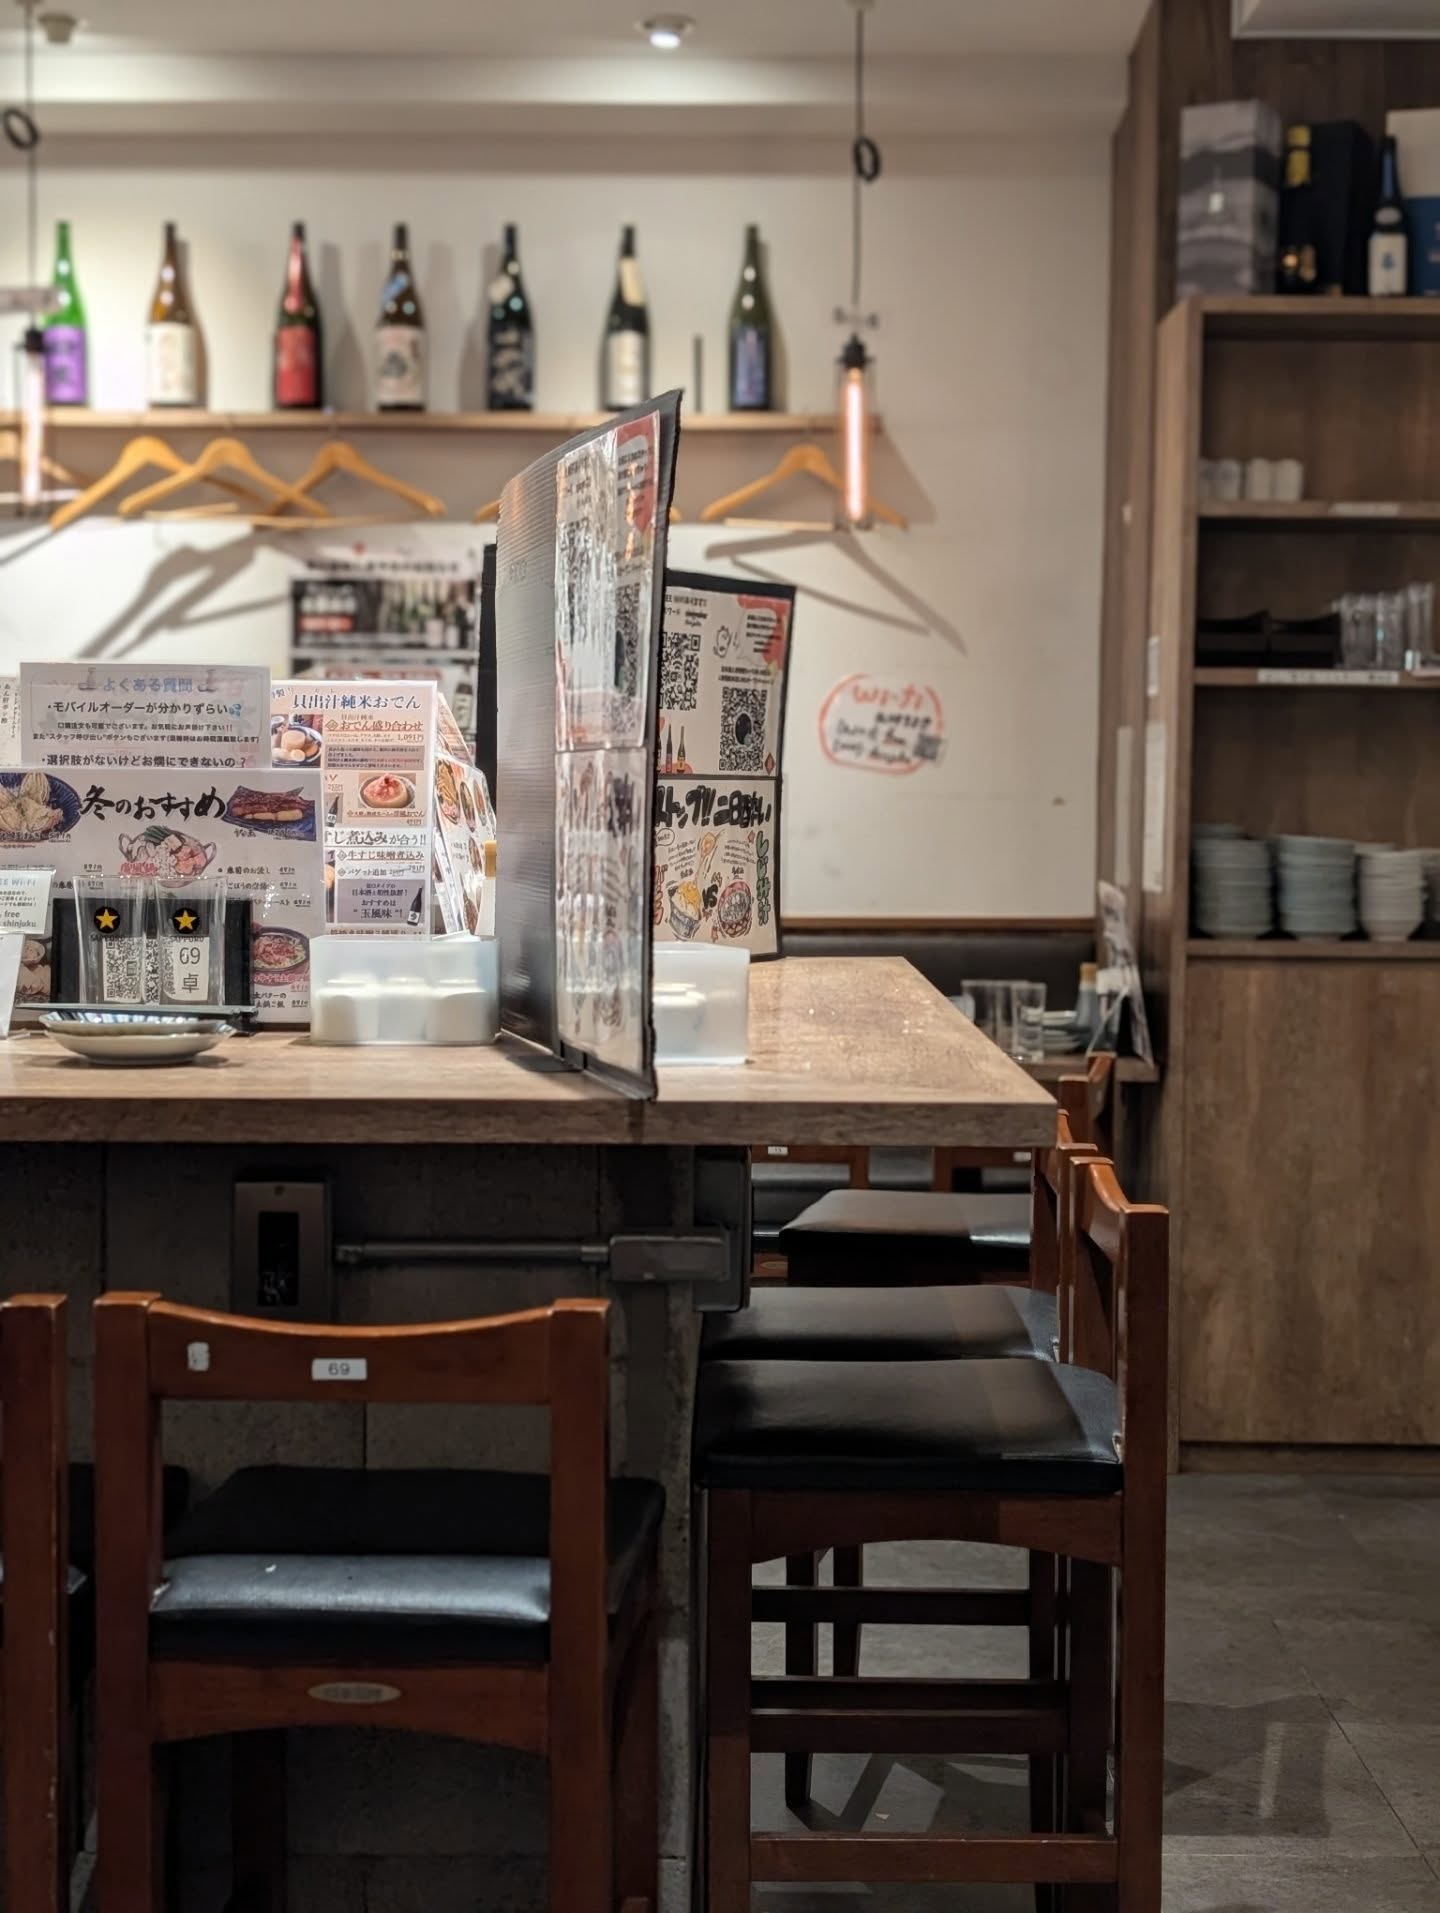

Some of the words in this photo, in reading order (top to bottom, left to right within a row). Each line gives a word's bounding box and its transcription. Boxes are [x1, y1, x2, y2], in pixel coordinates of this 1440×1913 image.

[103, 677, 193, 693] よくある質問
[79, 785, 228, 823] 冬のおすすめ
[3, 920, 37, 928] shinjuku
[180, 947, 200, 965] 69
[182, 973, 200, 993] 卓
[328, 1363, 350, 1376] 69
